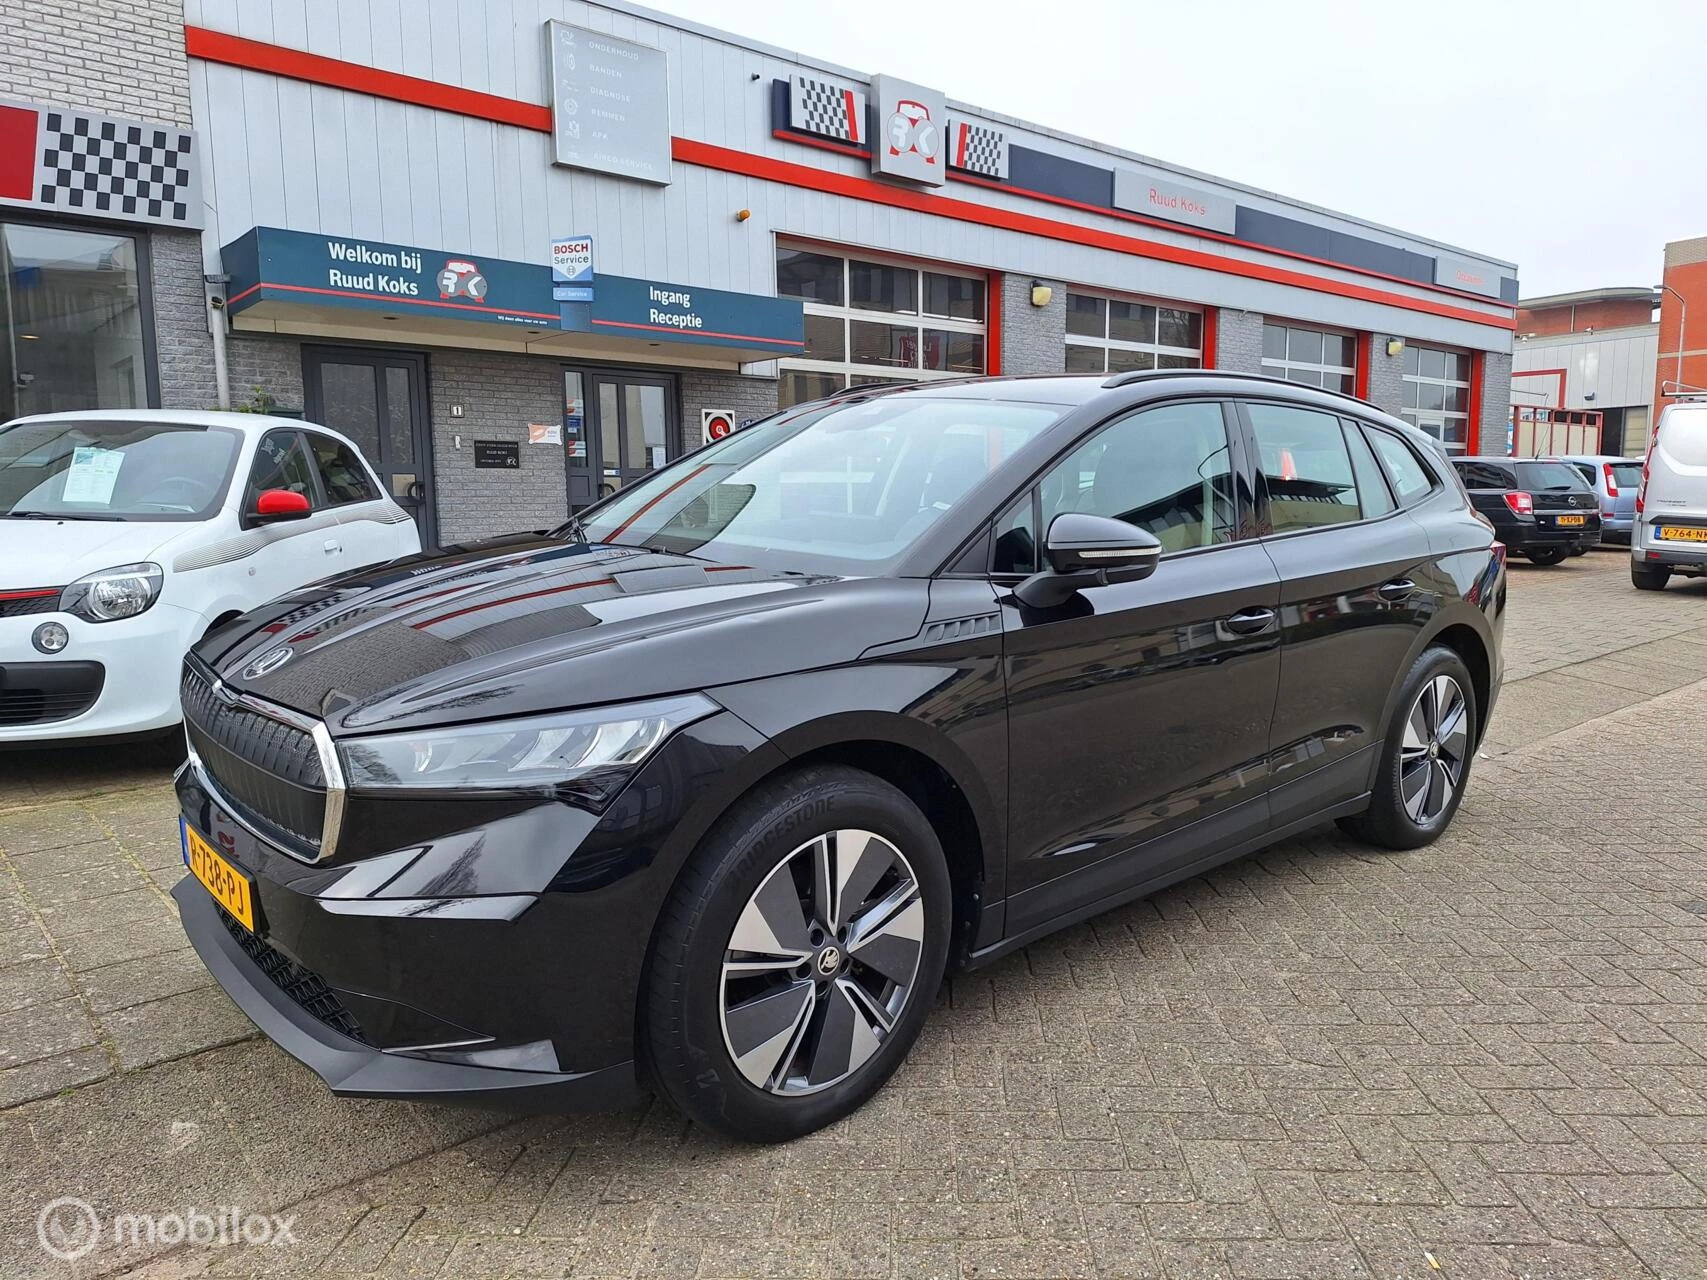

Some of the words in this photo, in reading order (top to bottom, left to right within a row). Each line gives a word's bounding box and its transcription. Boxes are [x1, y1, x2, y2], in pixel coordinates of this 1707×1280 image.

[589, 41, 639, 61] ONDERHOUD
[590, 64, 622, 78] BANDEN
[1149, 188, 1177, 210] Ruud
[1181, 197, 1206, 216] Koks
[328, 241, 397, 268] Welkom
[401, 251, 422, 274] bij
[554, 243, 588, 255] BOSCH
[554, 254, 589, 265] Service
[329, 269, 374, 291] Ruud
[378, 274, 419, 296] Koks
[649, 285, 691, 308] Ingang
[649, 308, 703, 329] Receptie
[190, 834, 244, 916] R-738-PJ
